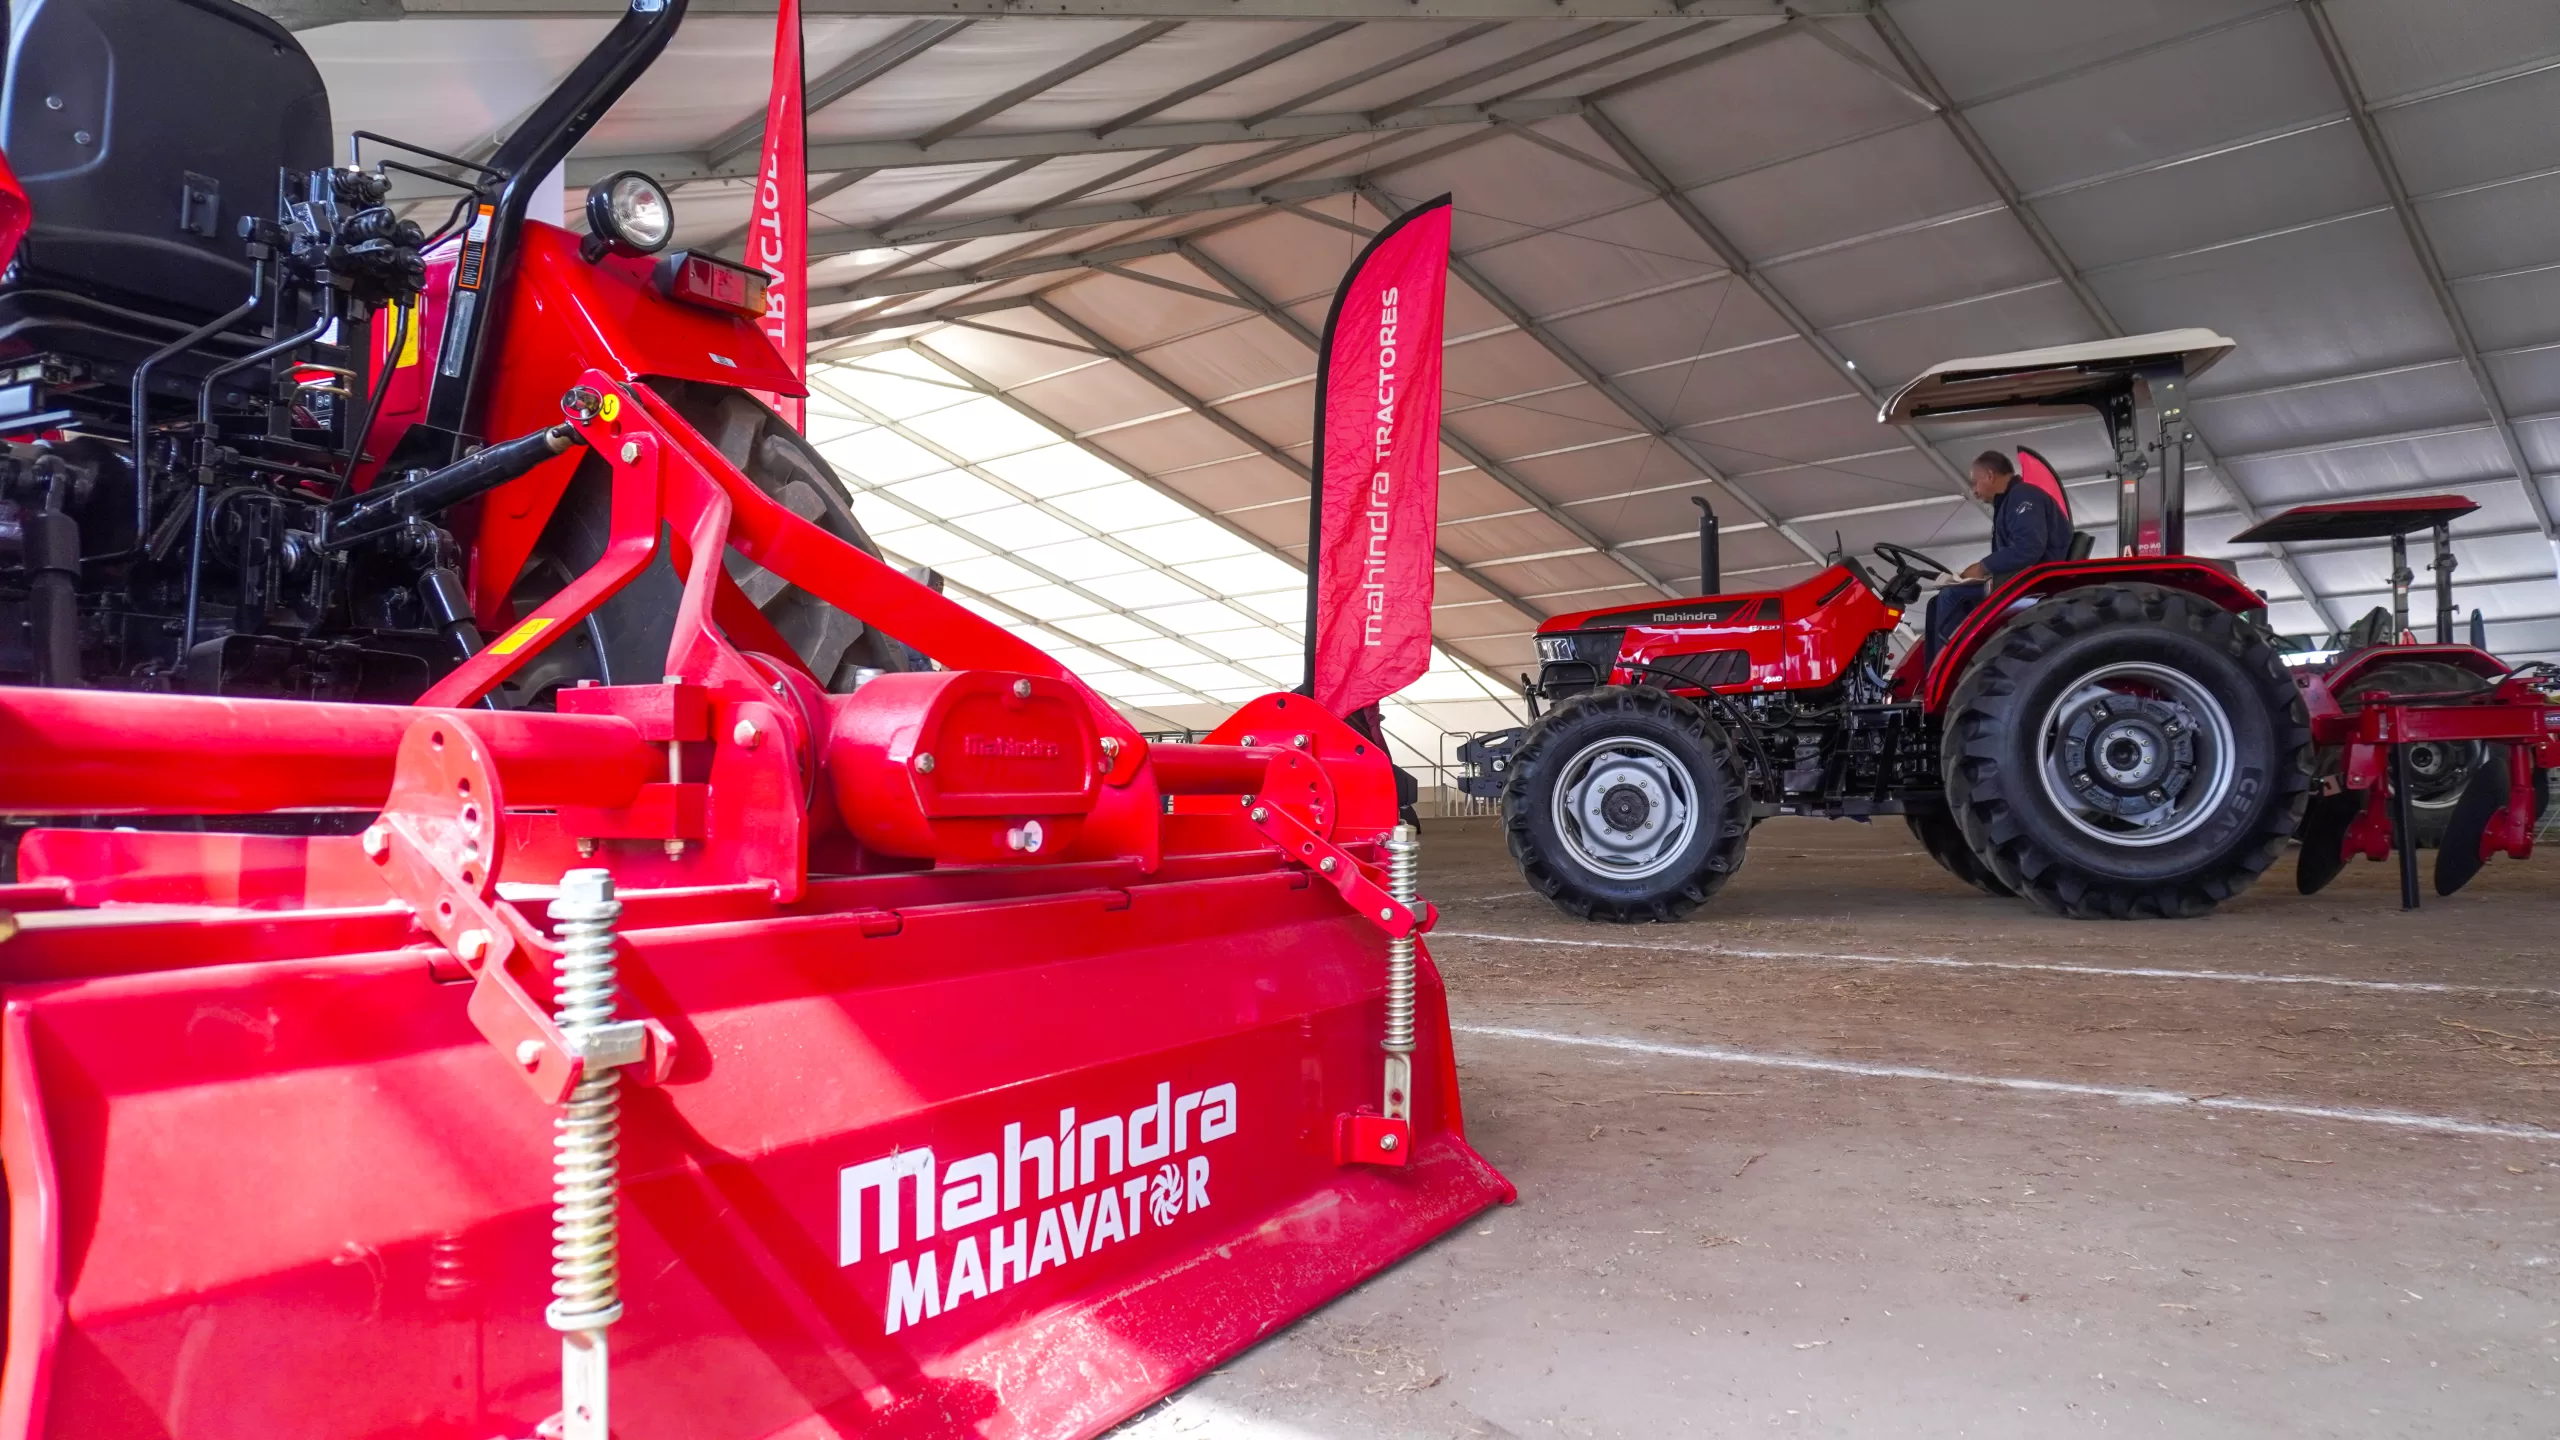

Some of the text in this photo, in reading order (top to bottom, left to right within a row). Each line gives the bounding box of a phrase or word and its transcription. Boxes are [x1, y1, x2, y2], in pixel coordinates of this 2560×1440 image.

[1363, 287, 1398, 646] mahindra TRACTORES
[1653, 611, 1717, 622] Mahindra
[1763, 676, 1782, 684] 4WD
[2212, 778, 2259, 843] CEAT
[840, 1081, 1237, 1267] Mahindra
